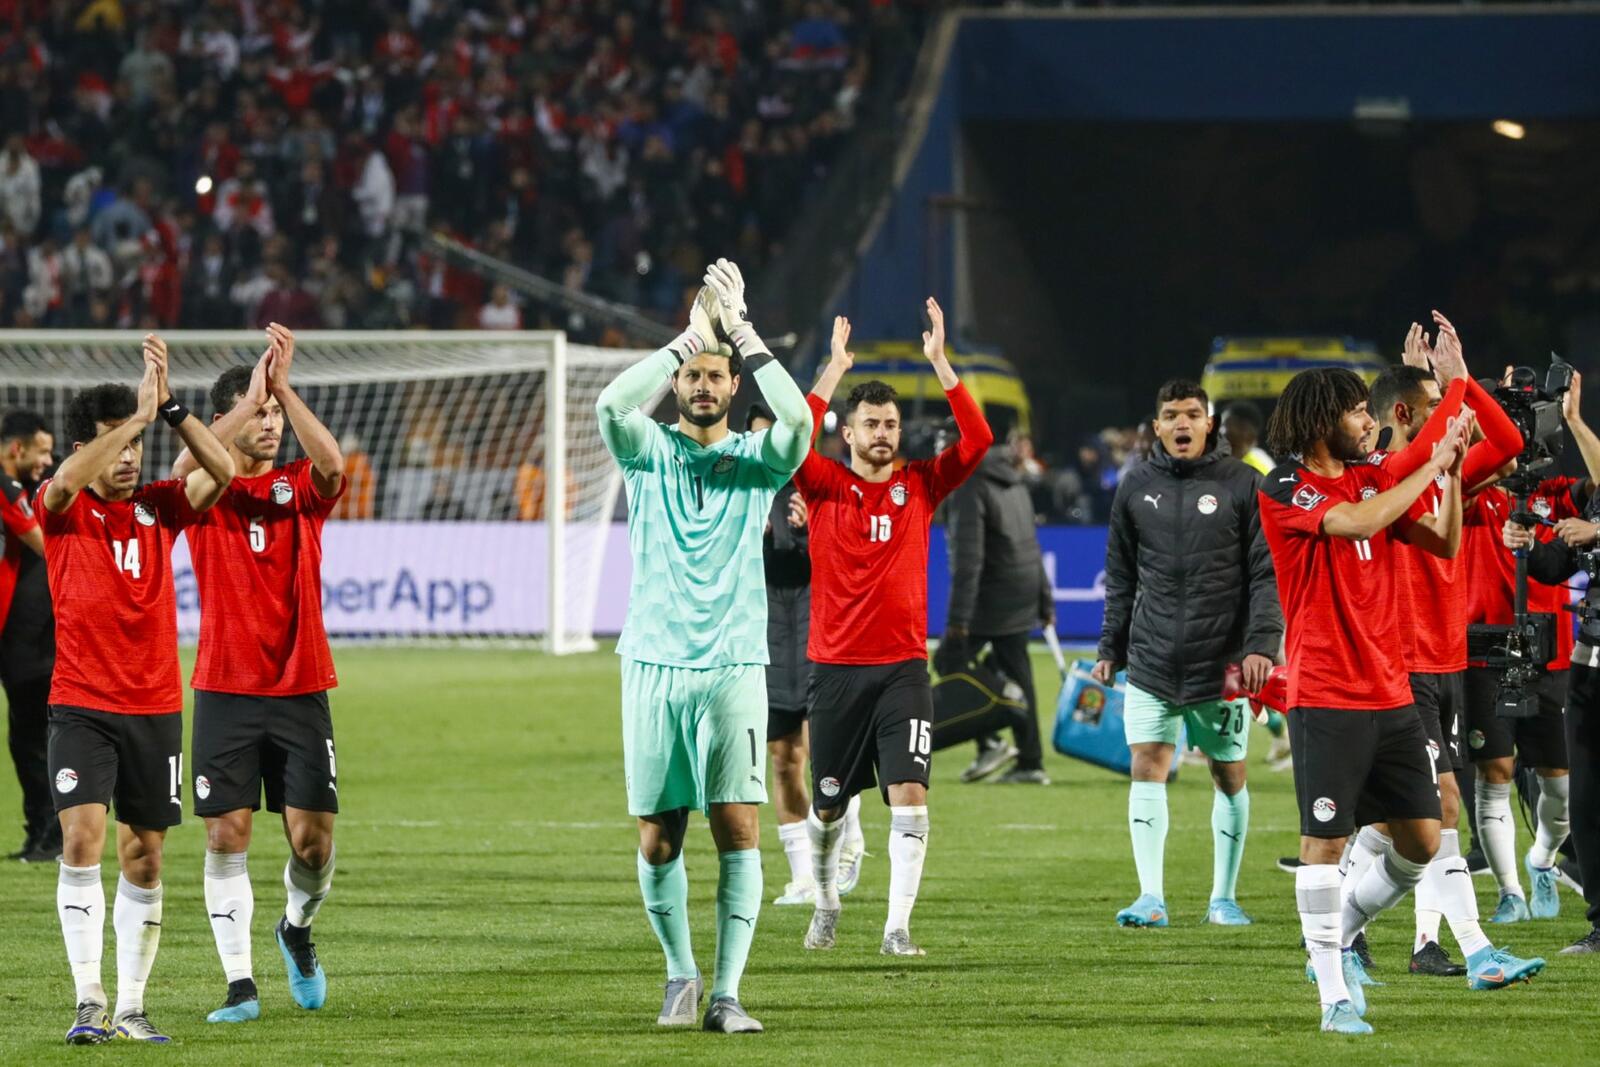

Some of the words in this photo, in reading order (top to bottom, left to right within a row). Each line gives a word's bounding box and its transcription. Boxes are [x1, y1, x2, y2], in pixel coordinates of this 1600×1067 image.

[694, 475, 704, 512] 1
[249, 517, 266, 553] 5
[870, 514, 892, 543] 15
[112, 538, 141, 579] 14
[909, 718, 931, 755] 15
[1218, 703, 1244, 737] 23
[747, 728, 756, 767] 1
